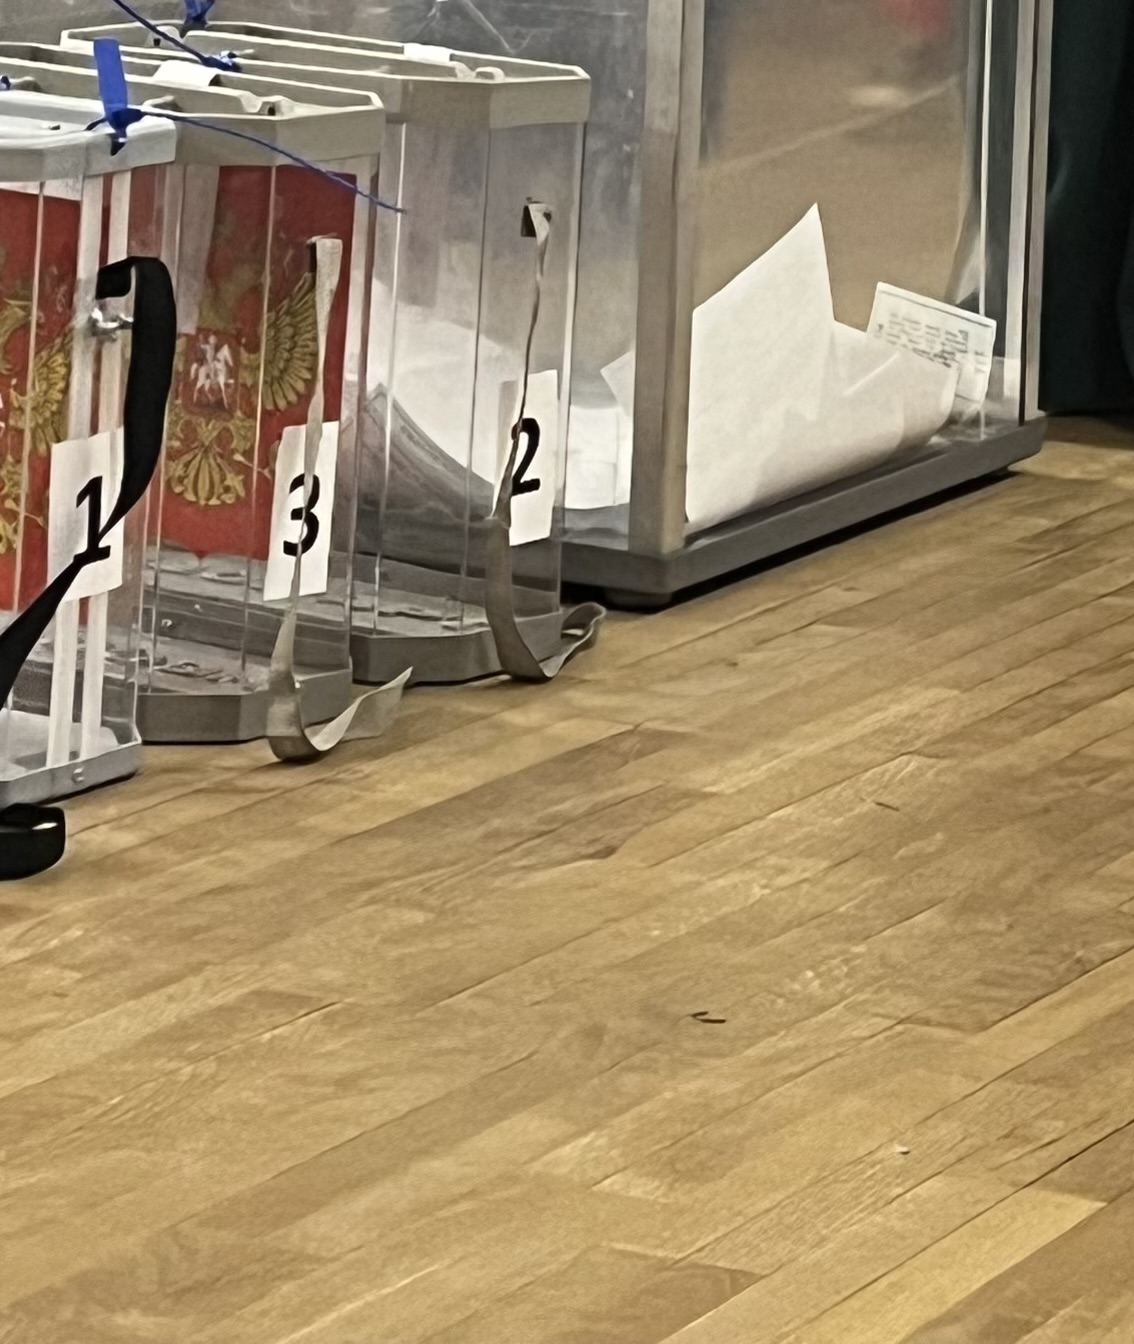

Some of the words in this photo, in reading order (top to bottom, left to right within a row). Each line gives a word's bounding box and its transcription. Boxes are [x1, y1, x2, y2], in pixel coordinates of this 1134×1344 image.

[511, 417, 541, 497] 2
[74, 475, 112, 564] 1
[282, 472, 321, 558] 3
